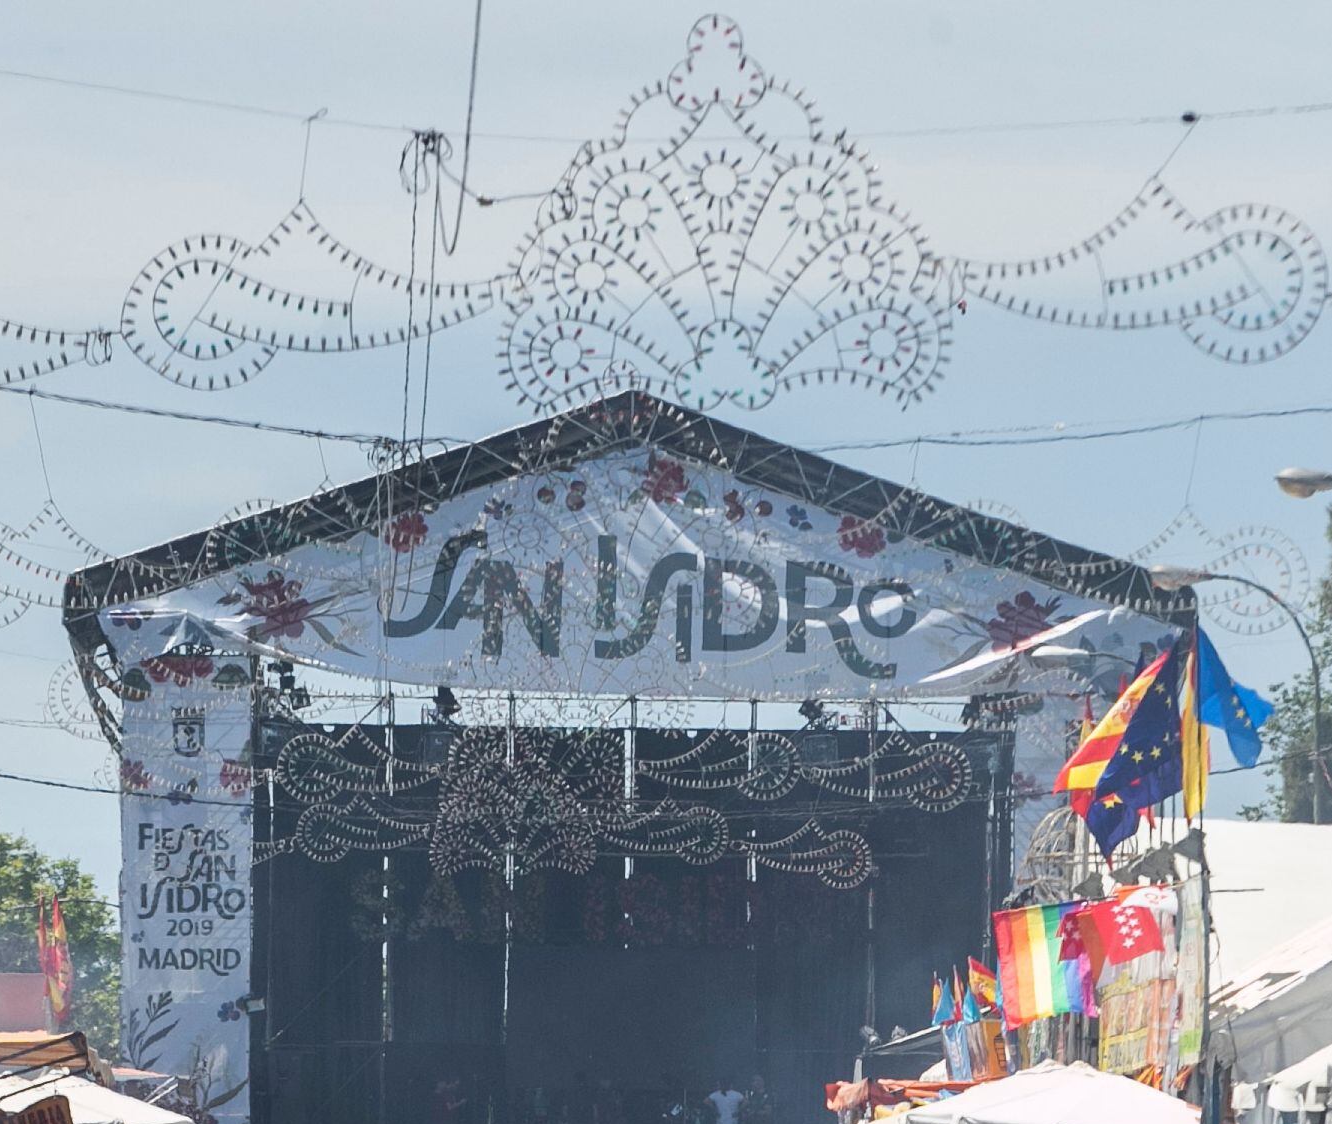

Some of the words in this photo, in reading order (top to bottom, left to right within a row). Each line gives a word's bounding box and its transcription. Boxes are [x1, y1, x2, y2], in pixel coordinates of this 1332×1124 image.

[383, 528, 564, 659] SAN
[594, 534, 917, 680] ISIDRO
[138, 823, 230, 854] FIESTAS
[178, 850, 236, 884] SAN
[137, 876, 246, 920] ISIDRO
[167, 918, 213, 937] 2019
[138, 947, 241, 977] MADRID
